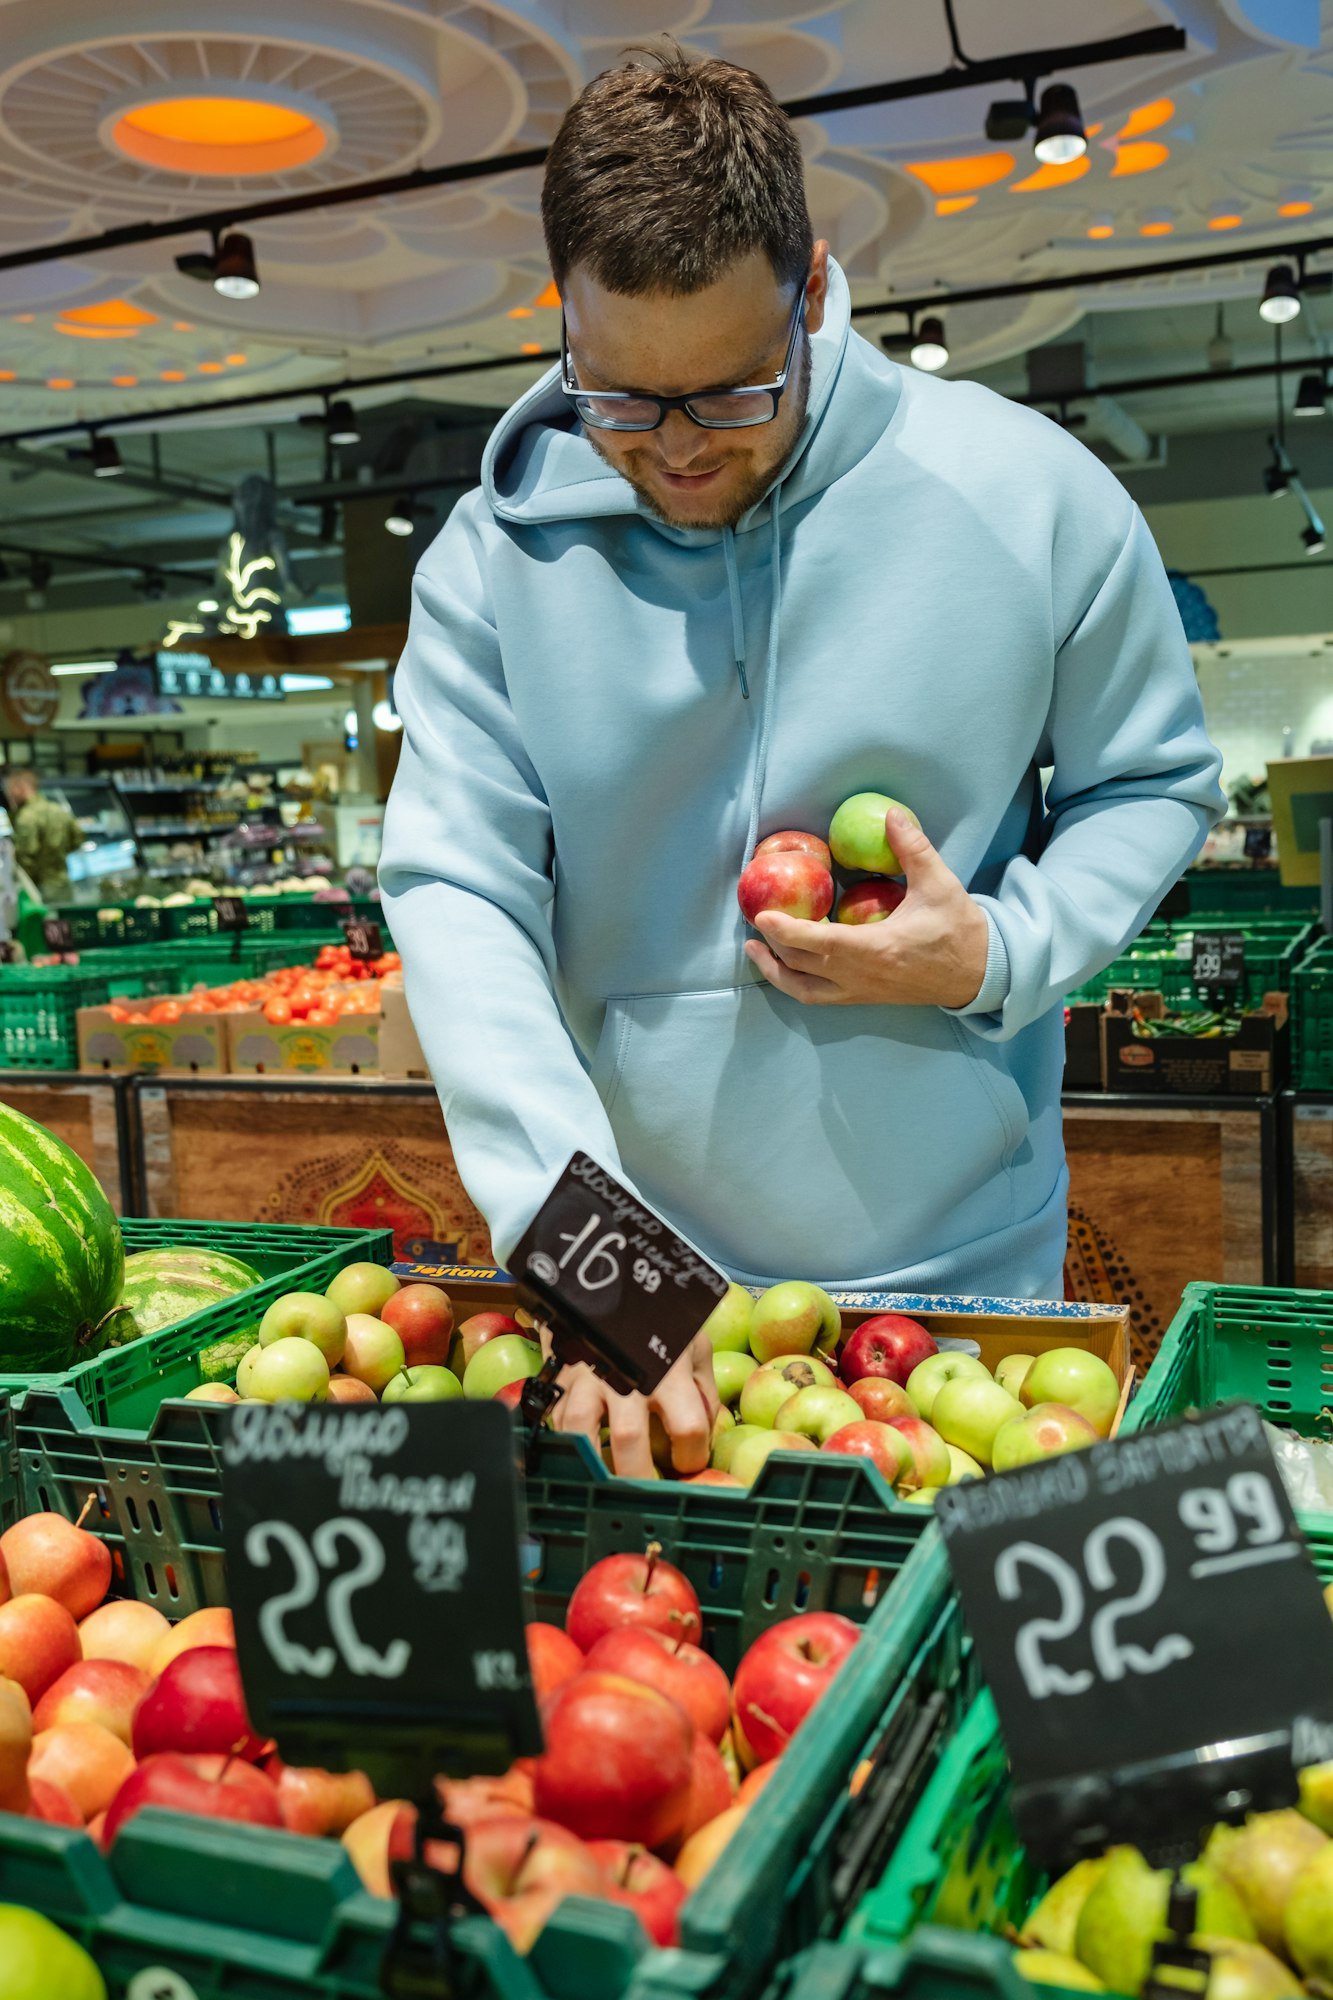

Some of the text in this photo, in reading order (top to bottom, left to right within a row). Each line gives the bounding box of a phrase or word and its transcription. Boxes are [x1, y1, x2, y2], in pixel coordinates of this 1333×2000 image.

[559, 1213, 627, 1291] 16
[632, 1258, 662, 1294] 99
[244, 1516, 411, 1677] 22
[994, 1471, 1286, 1698] 22 99
